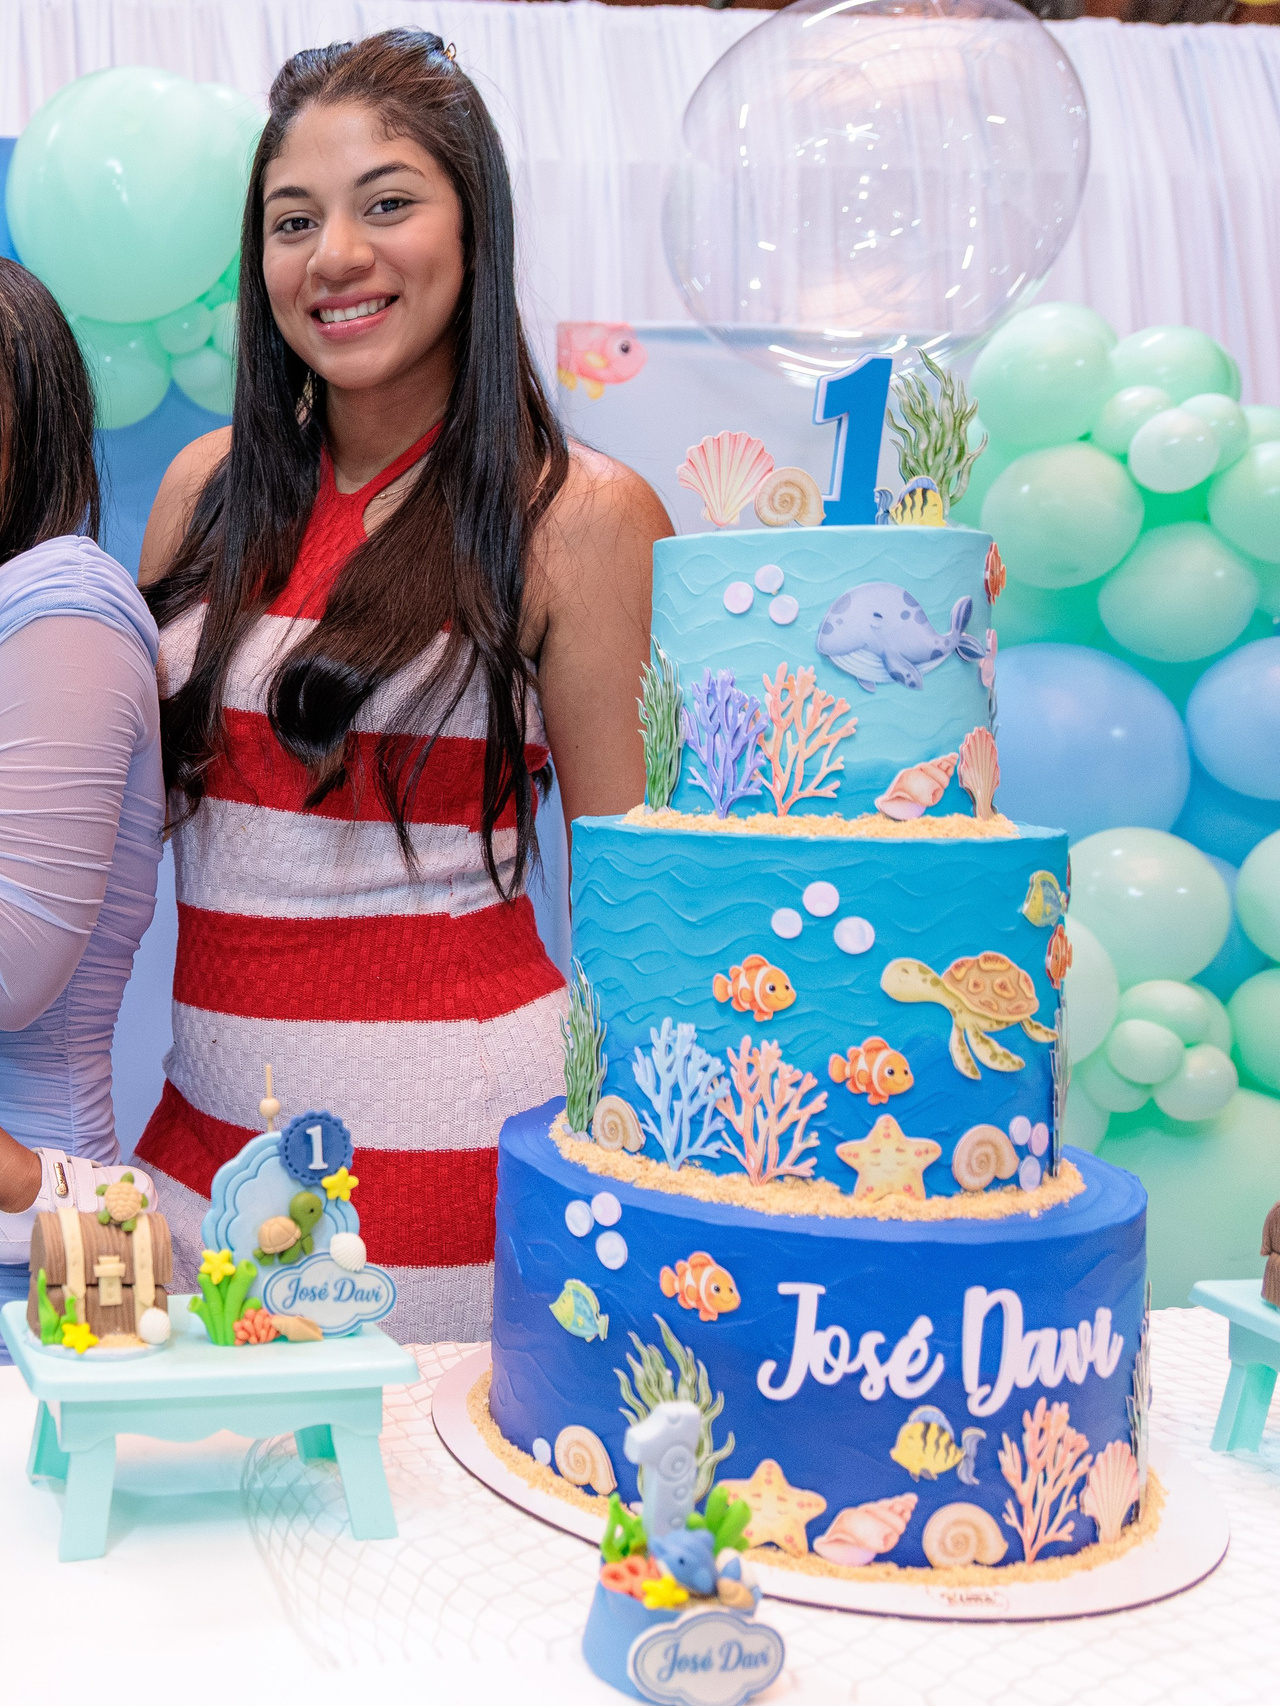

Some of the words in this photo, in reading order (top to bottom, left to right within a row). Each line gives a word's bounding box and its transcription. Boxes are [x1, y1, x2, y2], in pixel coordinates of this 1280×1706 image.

[814, 352, 892, 526] 1
[305, 1125, 329, 1170] 1
[282, 1277, 330, 1309] José
[333, 1278, 382, 1303] Davi
[757, 1282, 944, 1401] José
[962, 1285, 1124, 1416] Davi
[656, 1642, 713, 1683] José
